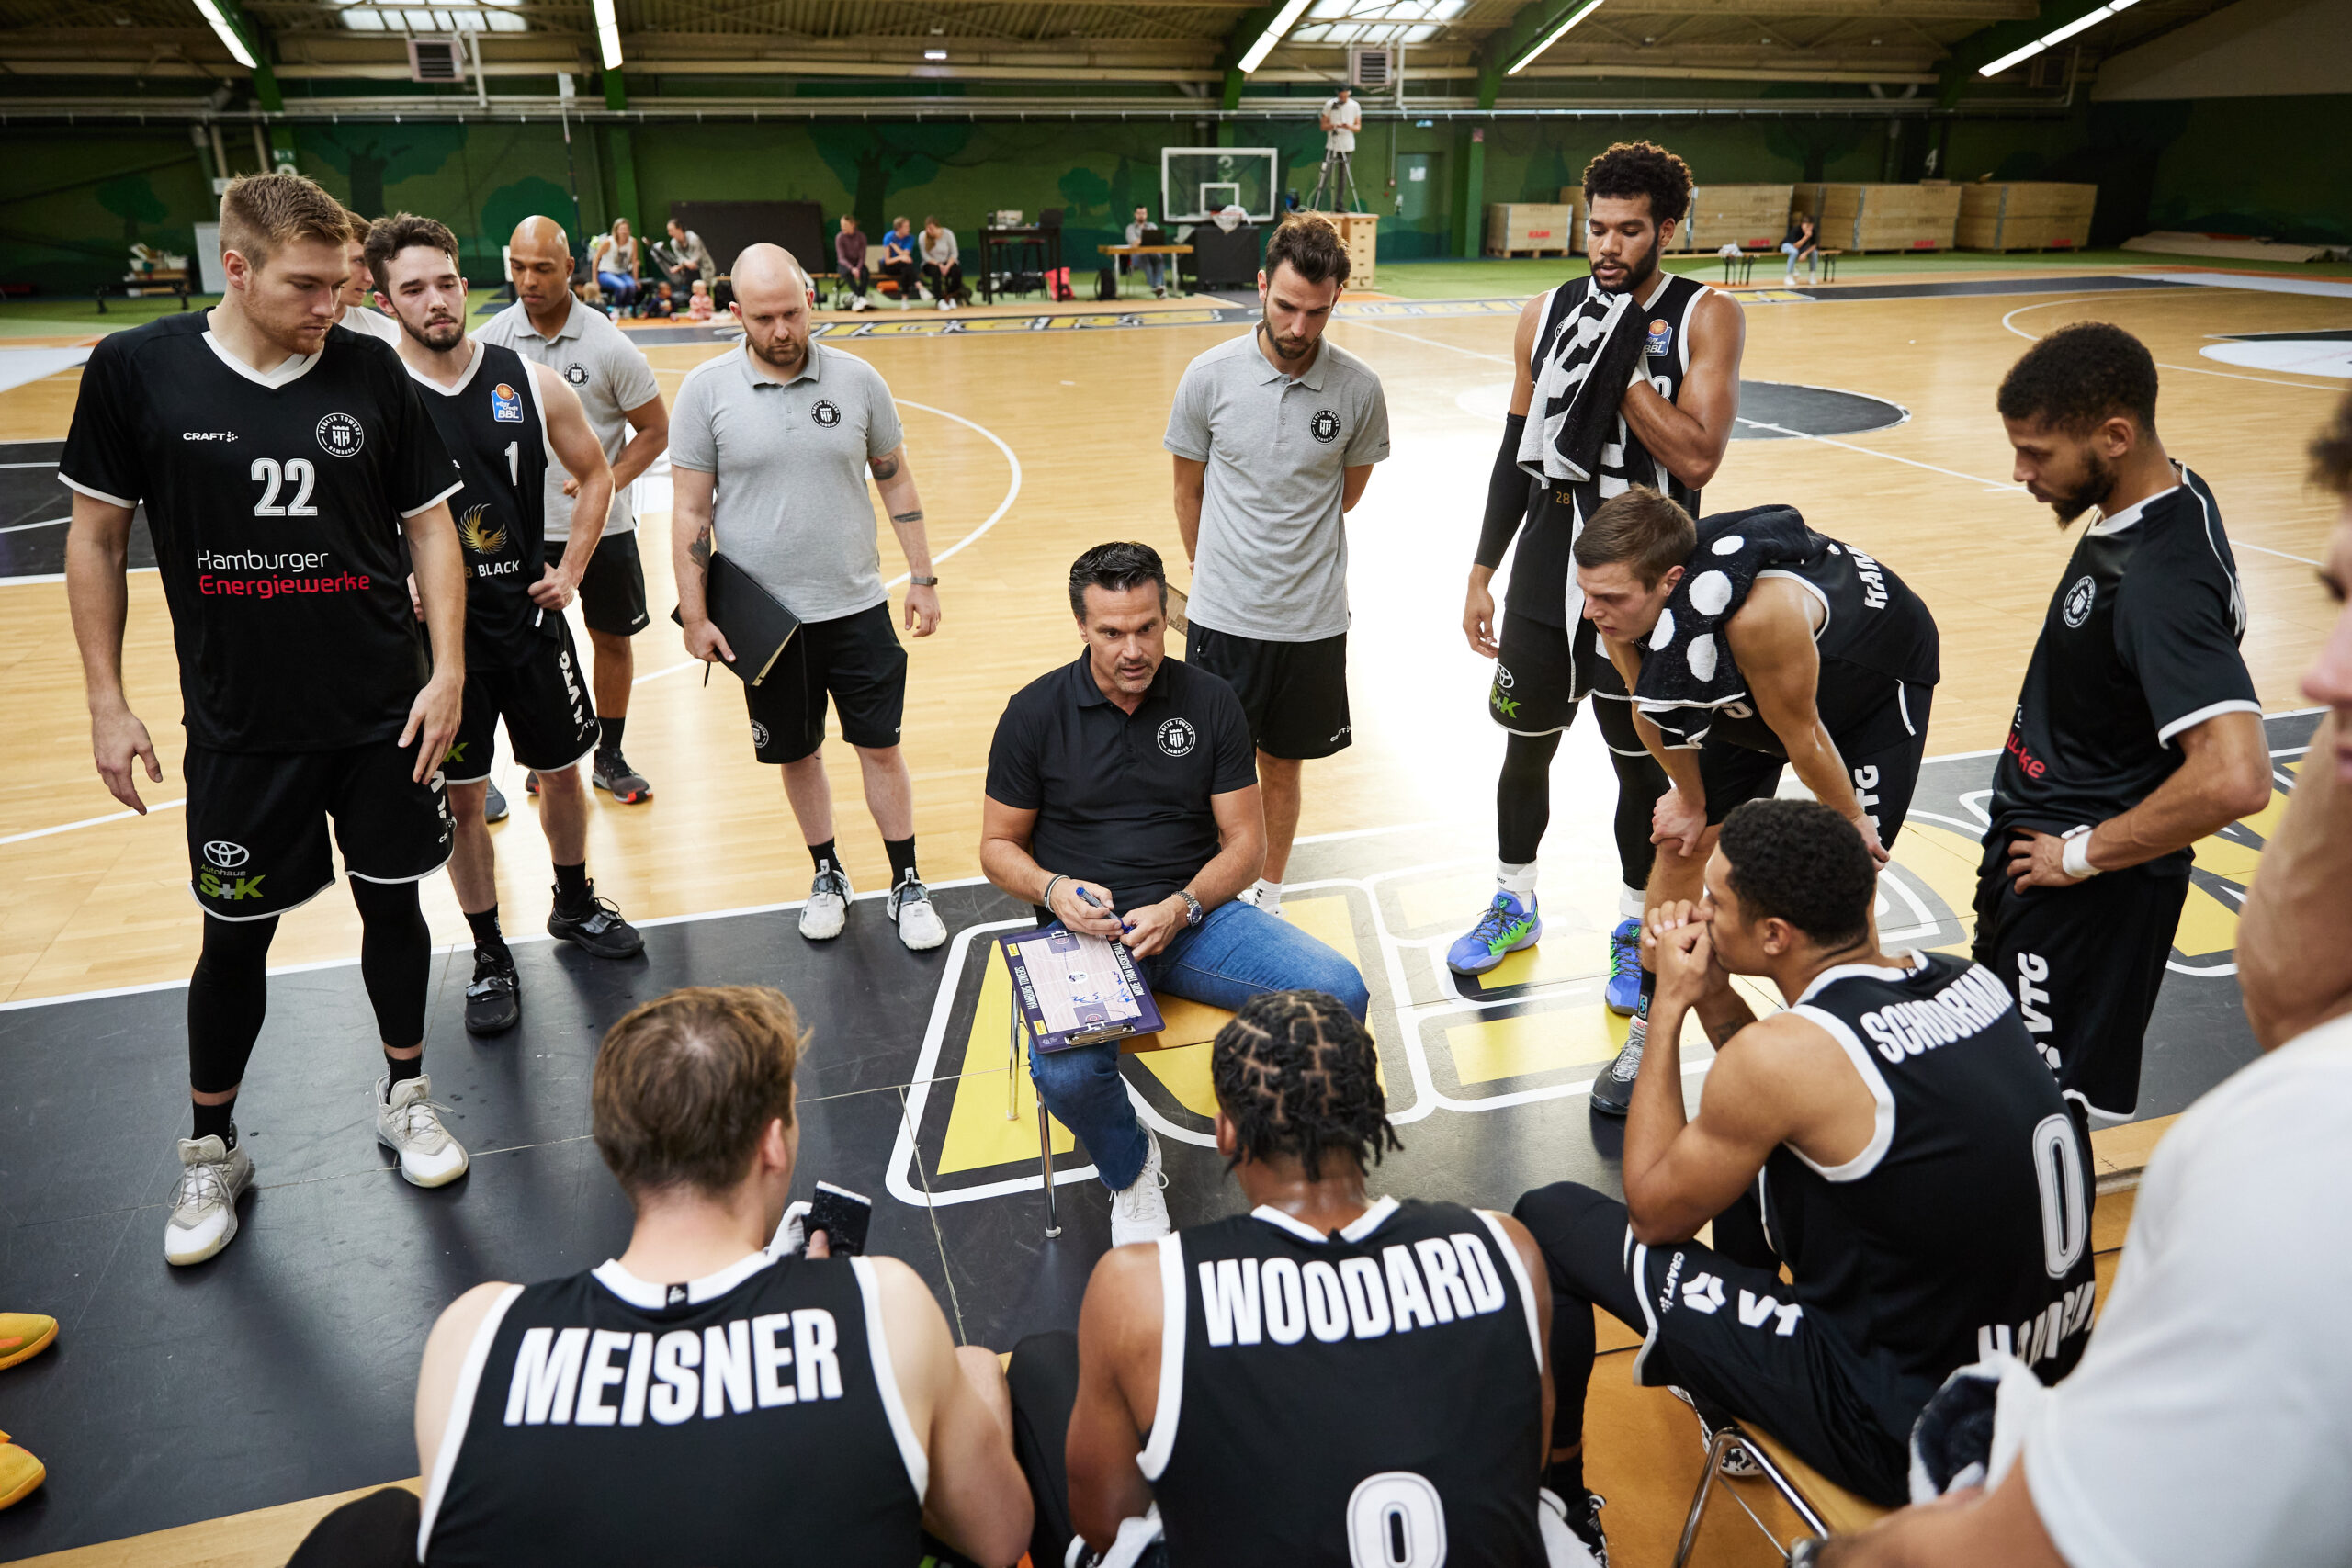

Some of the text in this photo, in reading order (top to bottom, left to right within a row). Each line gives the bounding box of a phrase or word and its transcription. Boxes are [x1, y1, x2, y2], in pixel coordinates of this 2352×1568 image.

[340, 415, 362, 436] TOWERS
[498, 410, 520, 419] BBL
[183, 432, 226, 441] CRAFT
[504, 441, 518, 486] 1
[251, 457, 318, 516] 22
[1556, 491, 1570, 504] 28
[197, 549, 329, 572] Hamburger
[478, 559, 520, 578] BLACK
[199, 570, 370, 599] Energiewerke
[200, 863, 247, 877] Autohaus
[199, 872, 266, 900] S+K
[2018, 952, 2053, 1032] VTG
[2032, 1112, 2087, 1279] 0
[1663, 1251, 1685, 1299] CRAFT
[1198, 1233, 1507, 1348] WOODARD
[503, 1308, 844, 1427] MEISNER
